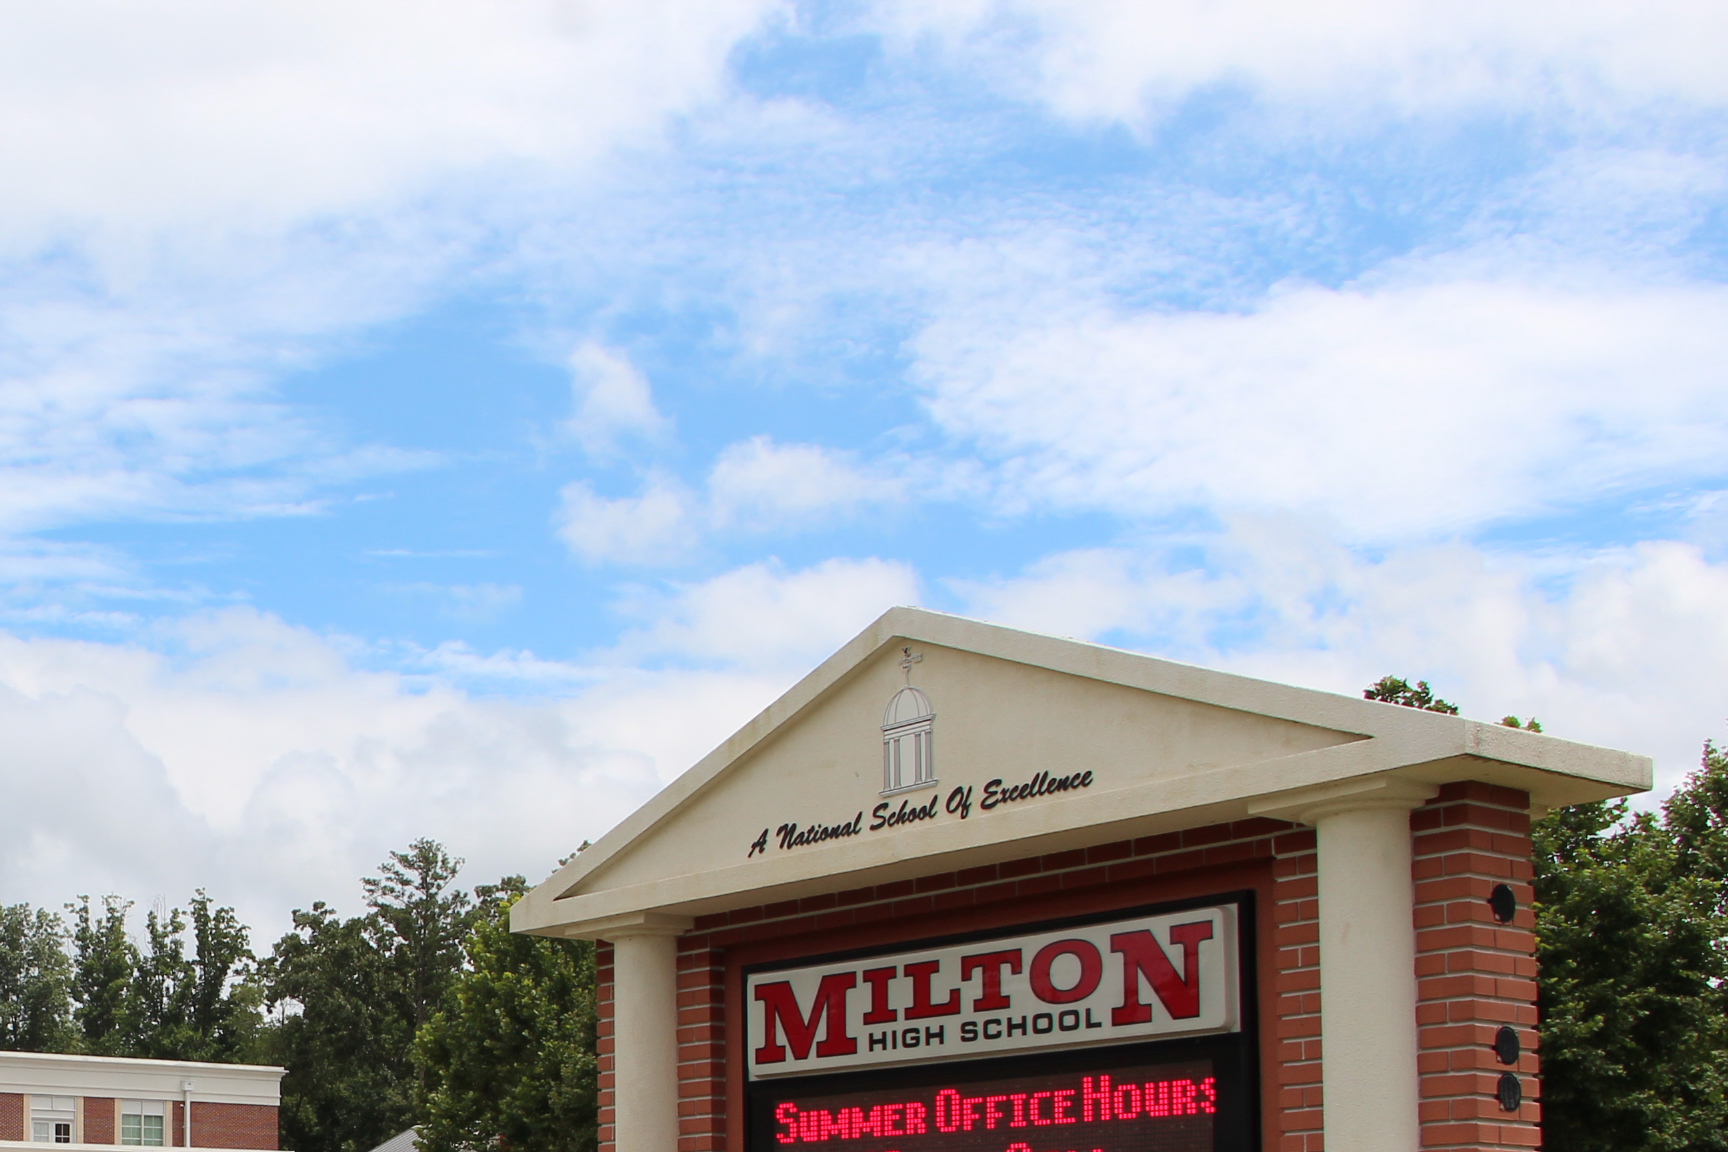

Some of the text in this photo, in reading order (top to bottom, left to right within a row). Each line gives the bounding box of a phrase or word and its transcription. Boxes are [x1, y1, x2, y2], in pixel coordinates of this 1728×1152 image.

[748, 769, 1093, 858] A National School Of Excellence
[754, 919, 1214, 1065] MILTON
[869, 1008, 1102, 1052] HIGH SCHOOL
